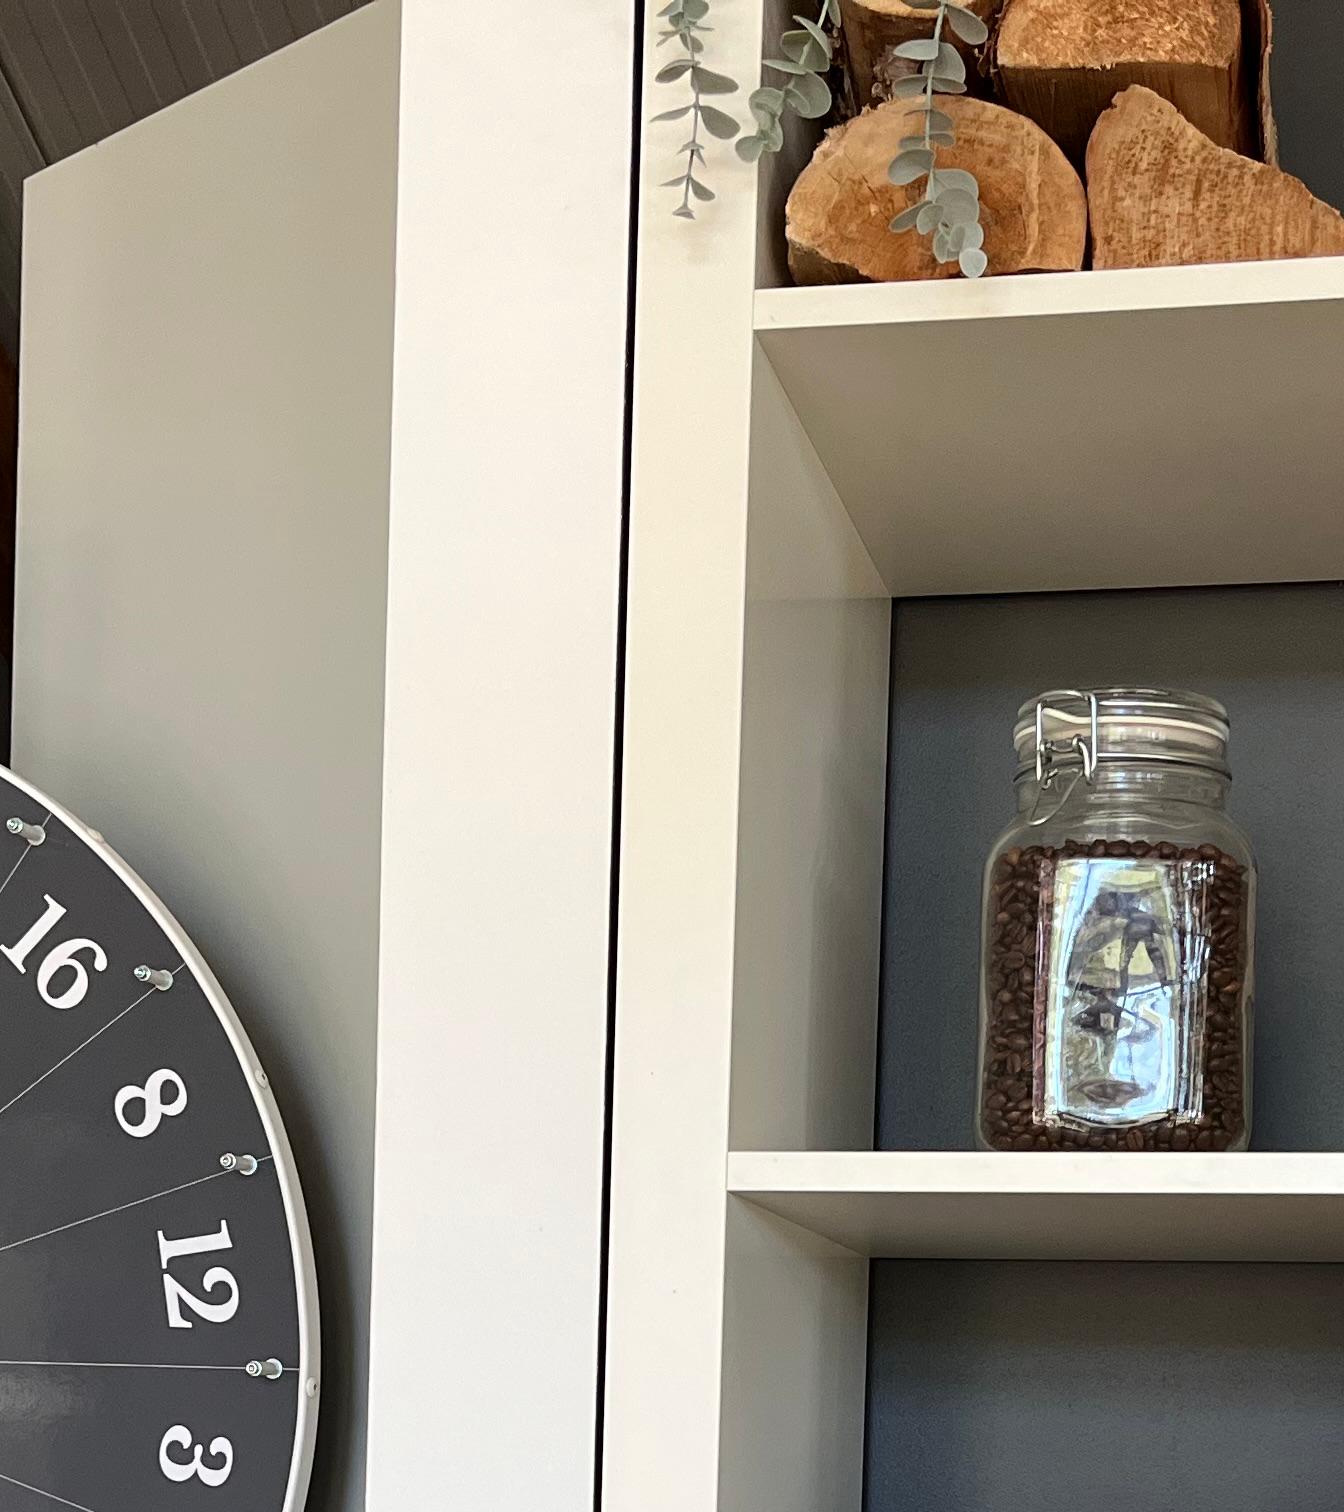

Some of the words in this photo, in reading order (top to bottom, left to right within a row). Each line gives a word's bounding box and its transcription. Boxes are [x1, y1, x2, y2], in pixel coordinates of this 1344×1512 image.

[0, 894, 107, 1009] 16
[115, 1069, 187, 1137] 8
[158, 1220, 239, 1328] 12
[160, 1425, 233, 1486] 3
